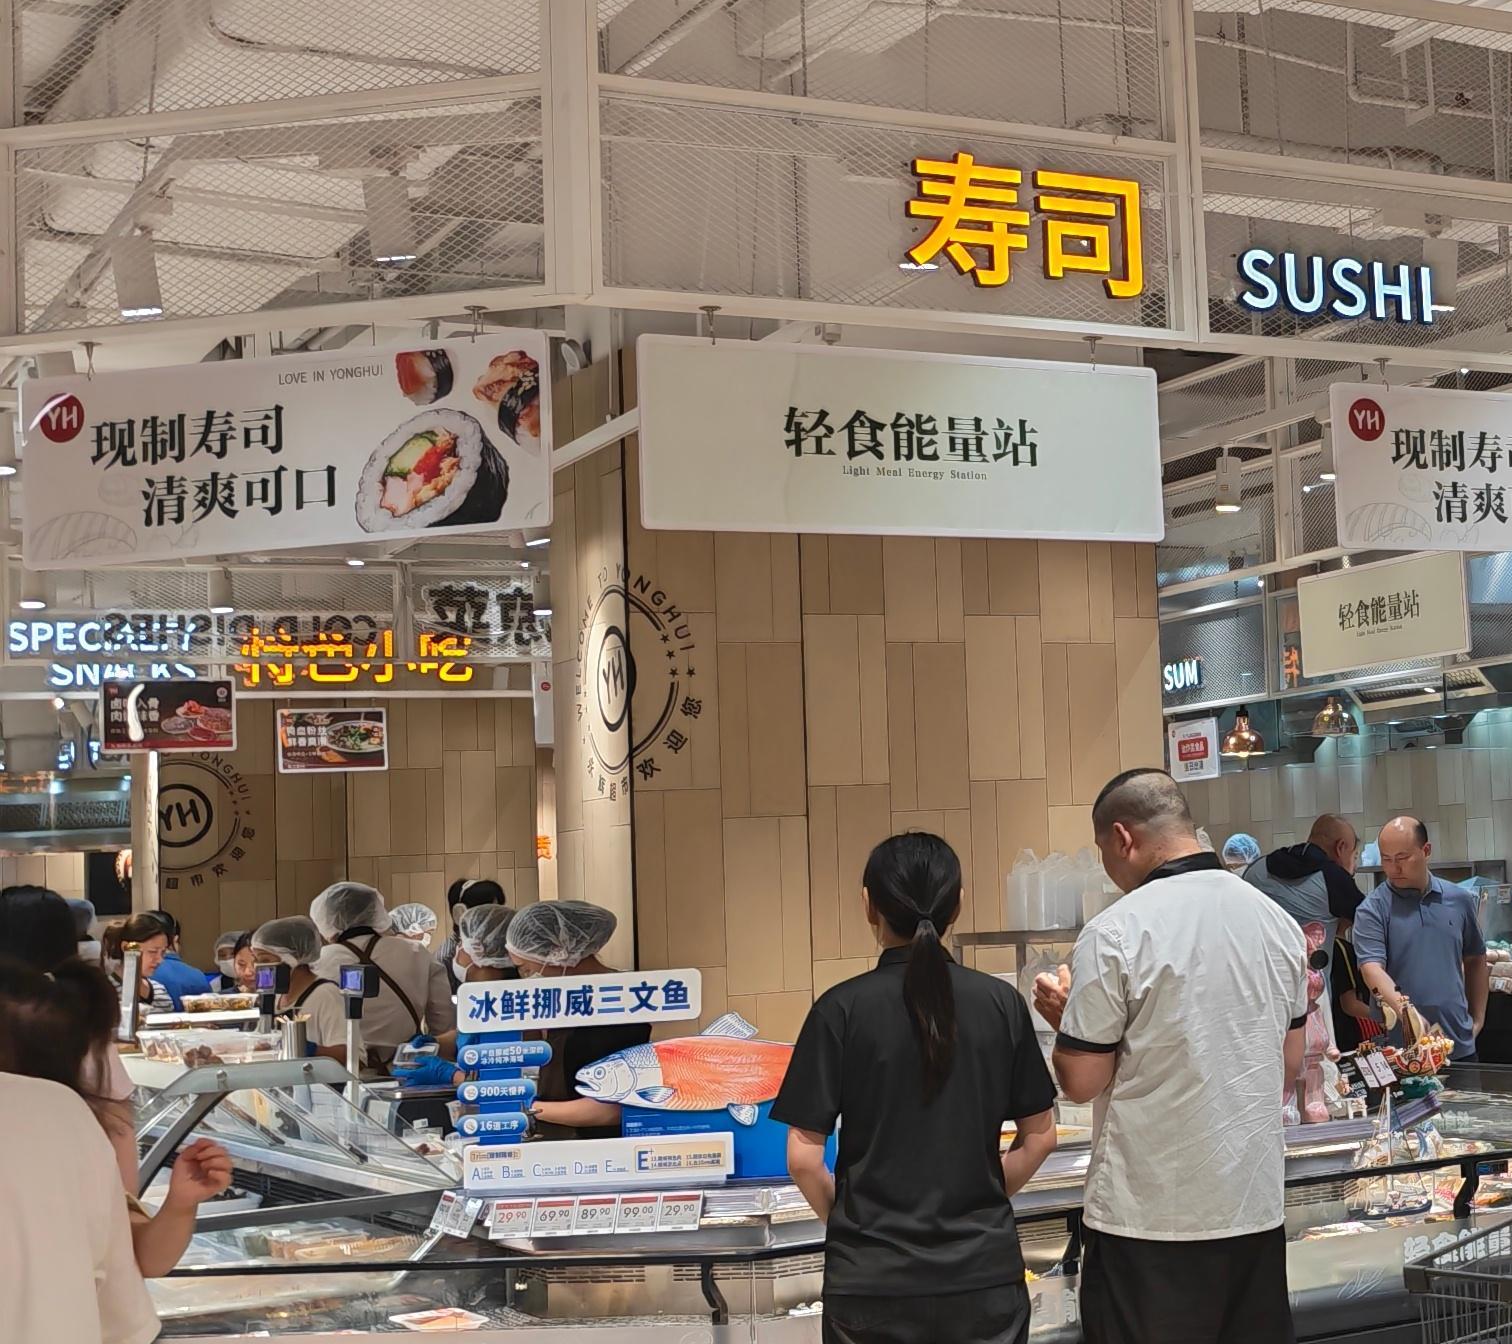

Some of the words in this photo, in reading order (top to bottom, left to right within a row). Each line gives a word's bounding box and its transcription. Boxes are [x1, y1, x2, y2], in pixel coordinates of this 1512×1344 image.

[905, 151, 1143, 299] 寿司
[1240, 249, 1434, 323] SUSHI
[278, 372, 307, 385] LOVE
[313, 370, 325, 382] IN
[330, 364, 384, 380] YONGHUI
[48, 406, 78, 431] YH
[90, 404, 284, 471] 现制寿司
[784, 405, 1039, 467] 轻食能量站
[1354, 409, 1380, 431] YH
[141, 464, 337, 527] 清爽可口
[842, 465, 870, 476] Light
[876, 467, 902, 476] Meal
[908, 468, 944, 480] Energy
[950, 470, 987, 481] Station
[1339, 589, 1420, 631] 轻食能量站
[241, 626, 473, 685] 特色小吃
[602, 650, 625, 704] YH
[1164, 659, 1199, 691] SUM
[468, 979, 690, 1023] 冰鲜挪威三文鱼
